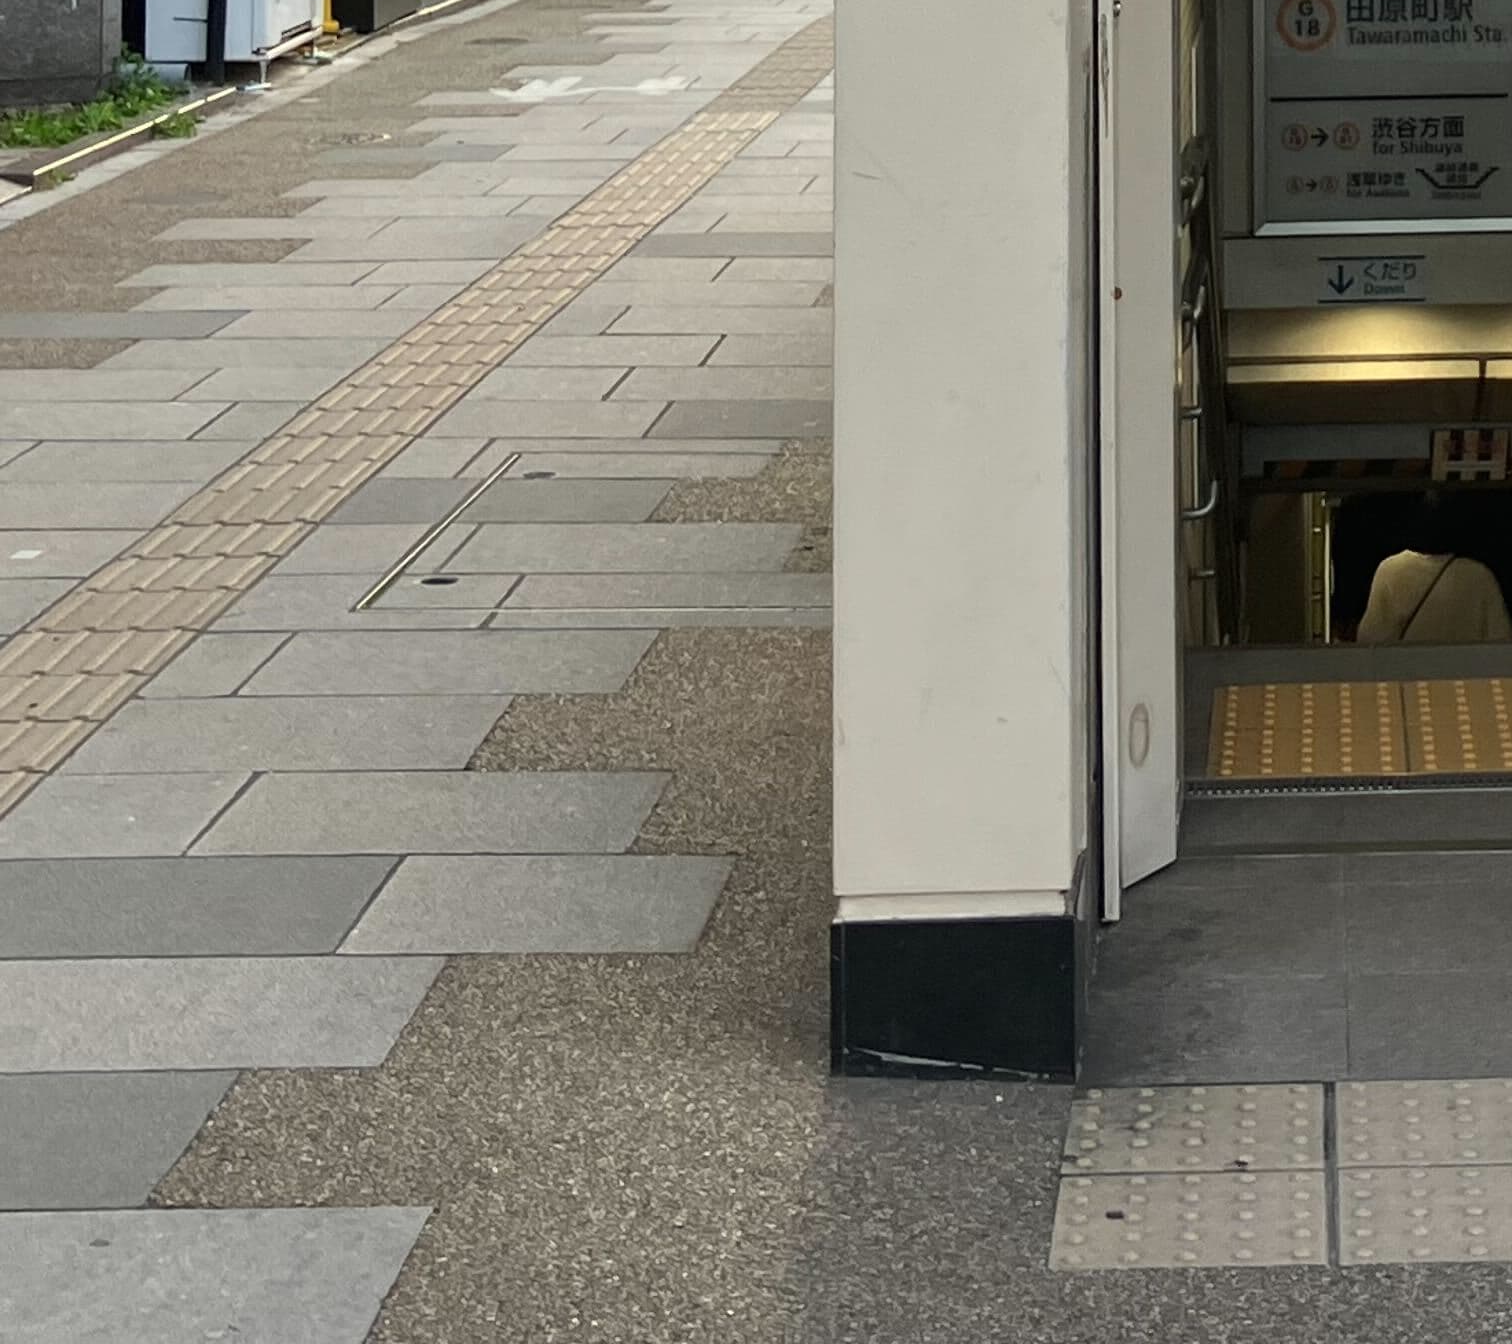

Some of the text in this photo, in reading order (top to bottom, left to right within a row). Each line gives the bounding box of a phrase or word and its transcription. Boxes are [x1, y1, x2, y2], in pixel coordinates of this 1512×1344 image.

[1294, 19, 1321, 36] 18
[1346, 25, 1467, 45] Tawaramachi
[1371, 116, 1465, 139] 渋谷方面
[1401, 140, 1463, 157] Shibuya
[1362, 262, 1417, 281] くだり
